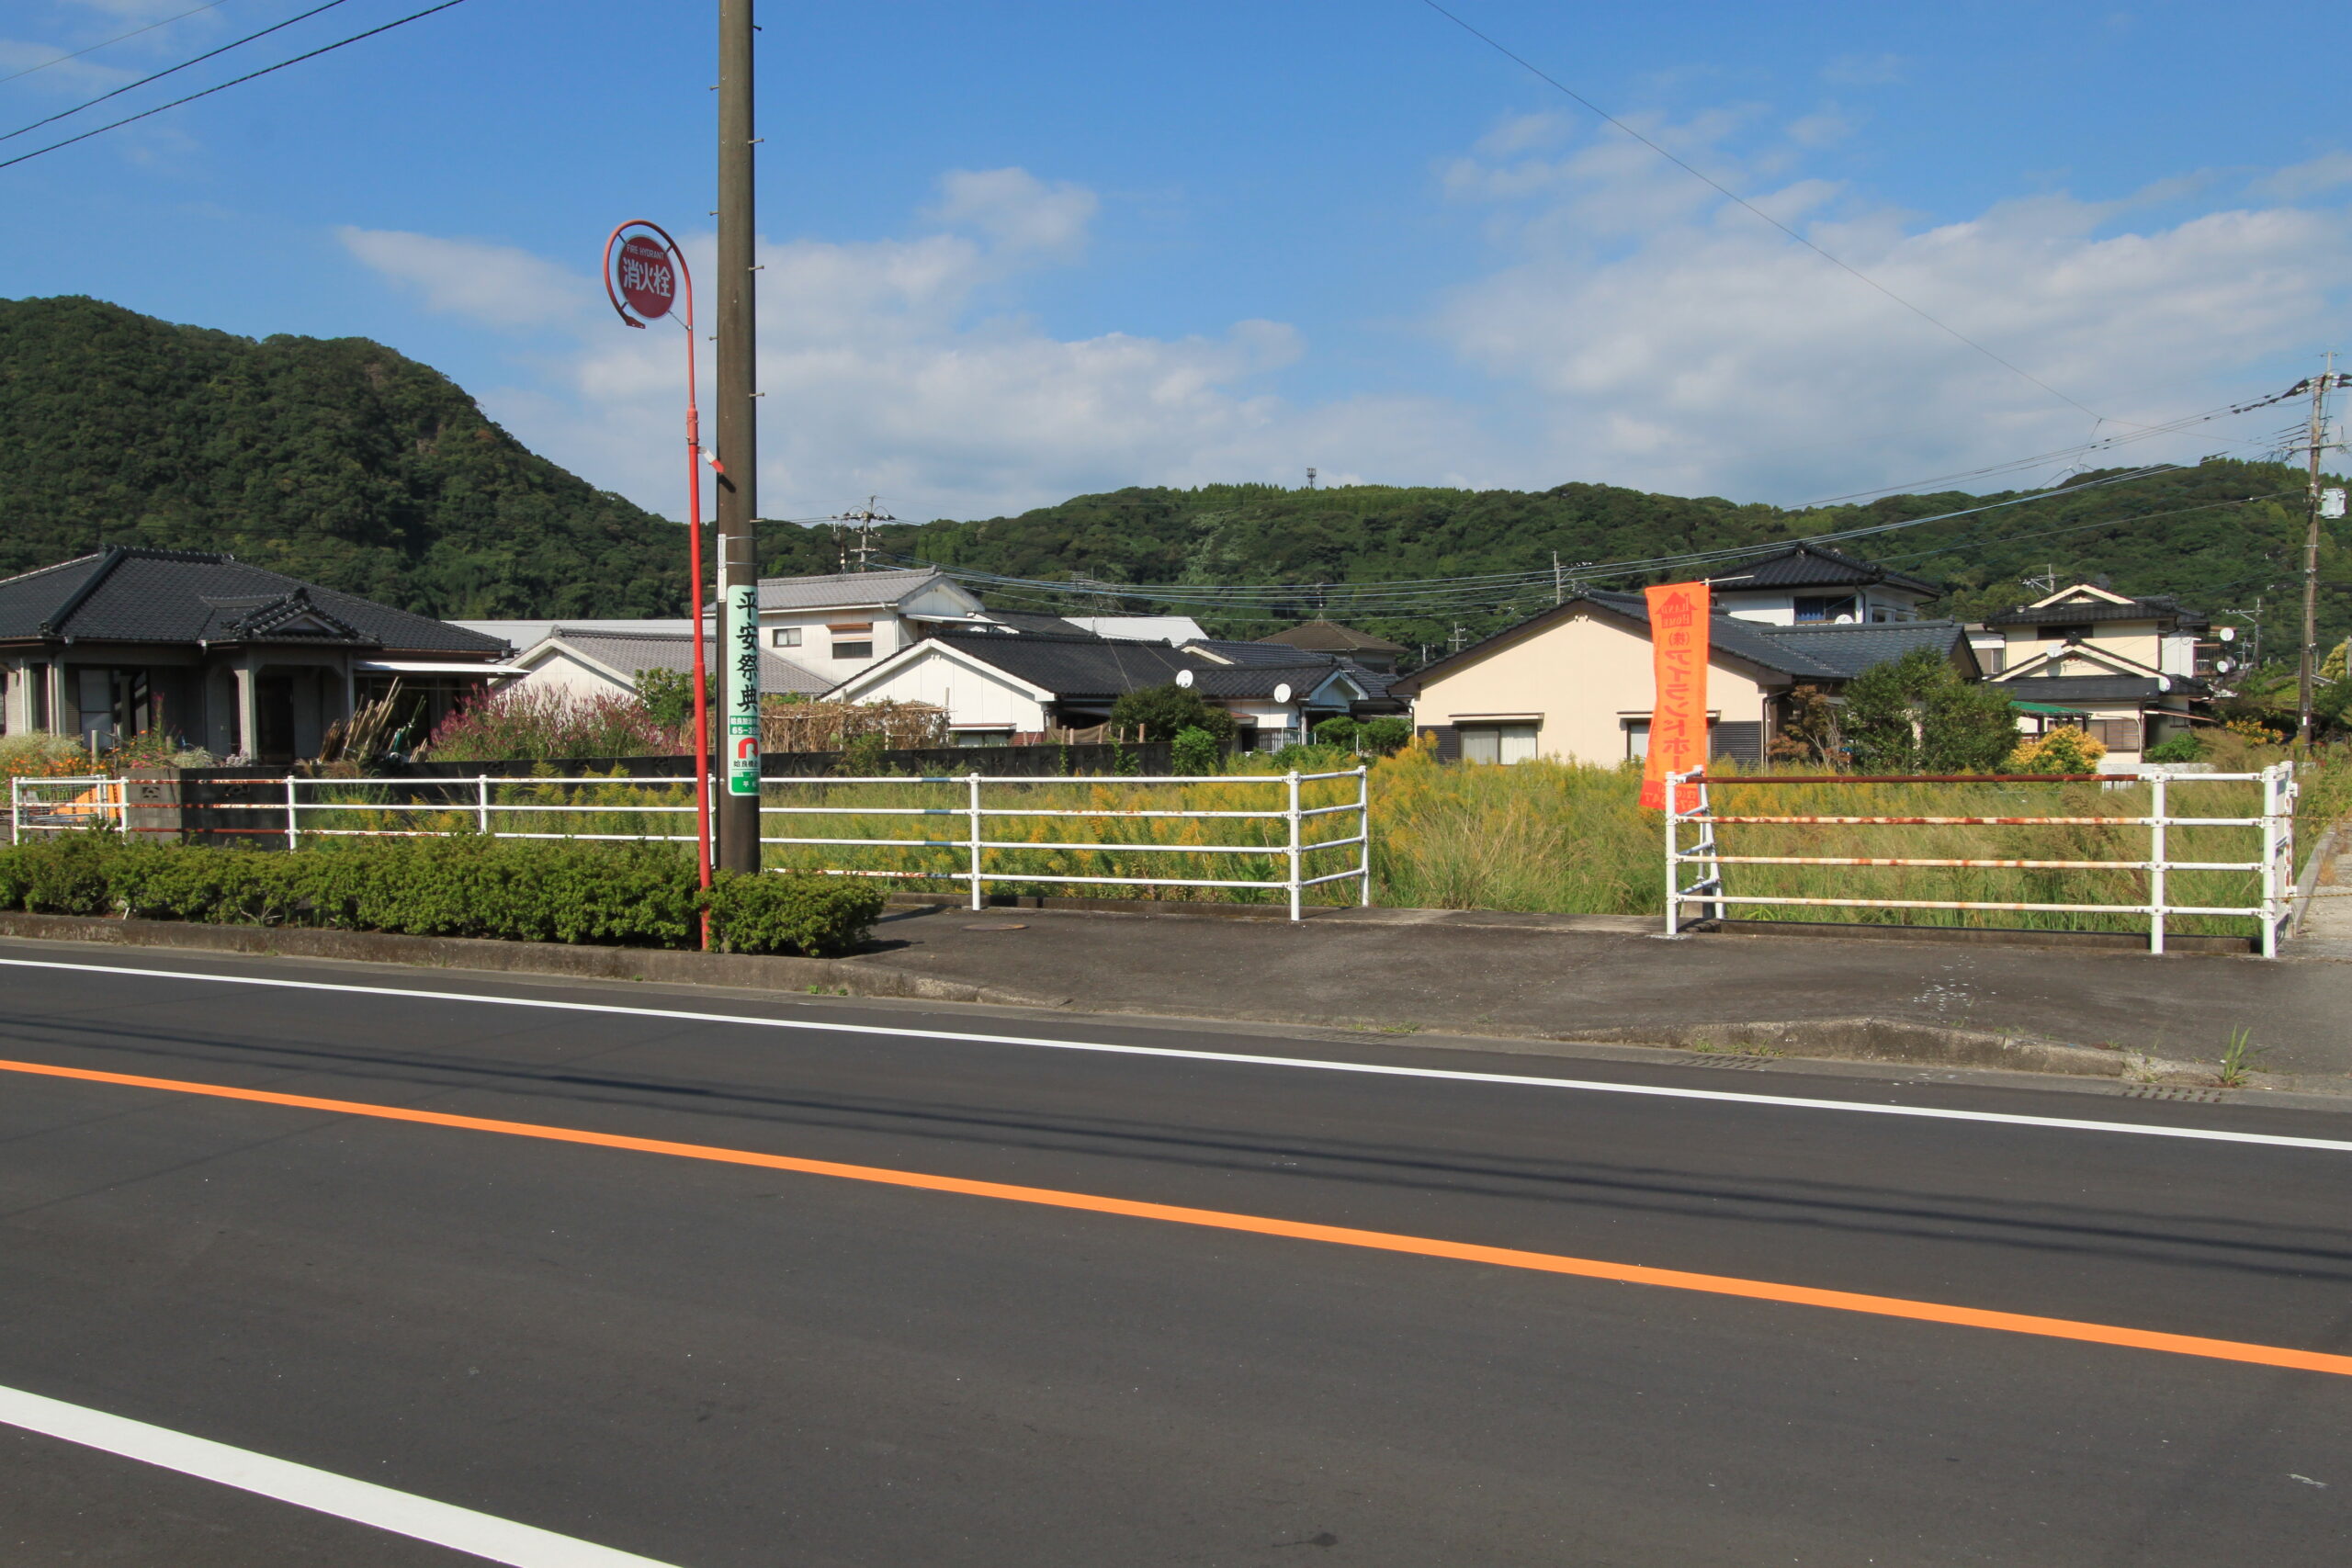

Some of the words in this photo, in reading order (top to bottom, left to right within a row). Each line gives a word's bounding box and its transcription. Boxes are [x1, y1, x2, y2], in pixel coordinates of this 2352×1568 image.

[627, 243, 639, 254] FIRE
[639, 247, 664, 260] HYDRANT
[623, 257, 671, 298] 消火栓
[735, 592, 758, 713] 平安祭典
